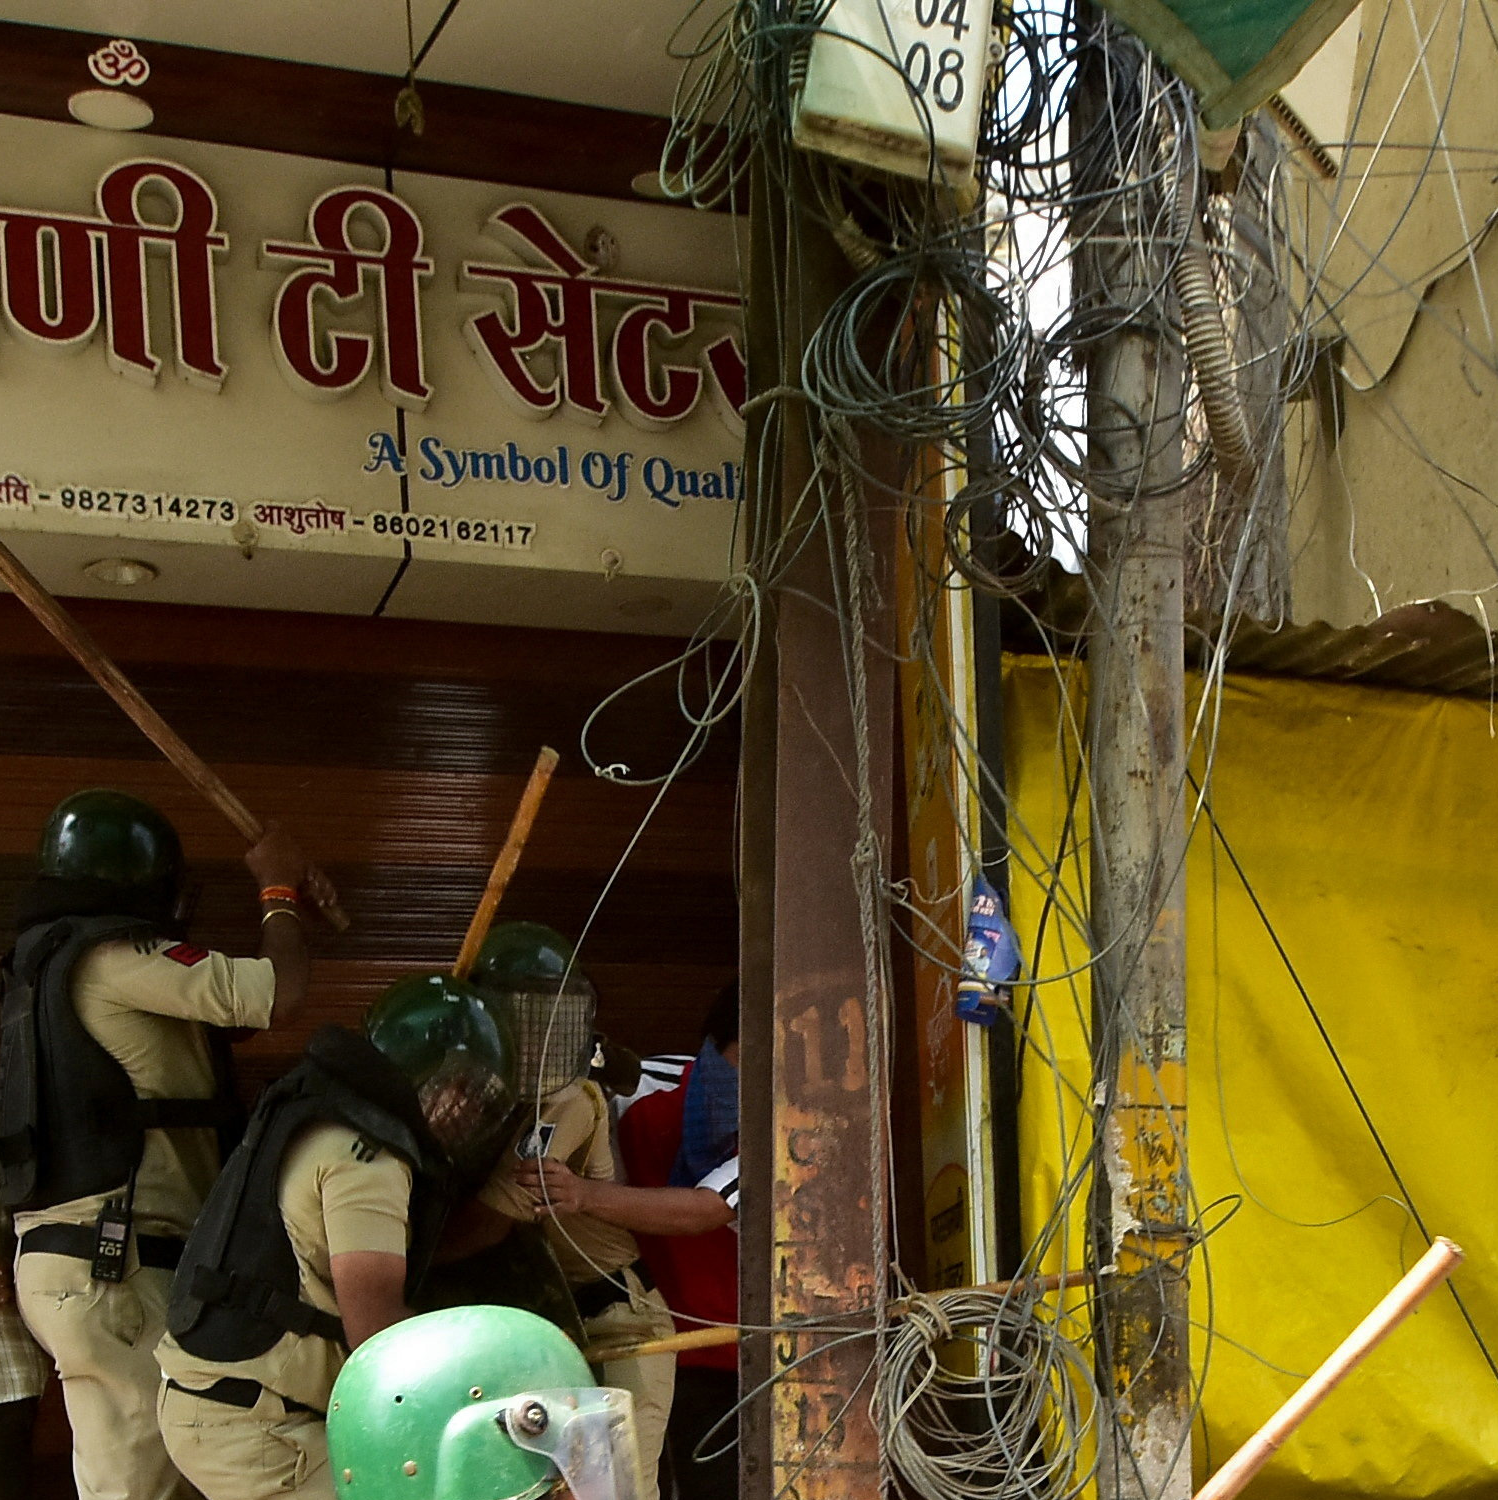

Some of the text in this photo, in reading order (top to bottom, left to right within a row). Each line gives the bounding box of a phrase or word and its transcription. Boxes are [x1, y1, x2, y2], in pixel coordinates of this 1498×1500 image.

[904, 42, 964, 112] 08
[264, 184, 434, 403] टी
[364, 432, 404, 475] A
[419, 436, 571, 489] Symbol
[581, 450, 633, 501] Of
[253, 501, 346, 535] आशुतोष
